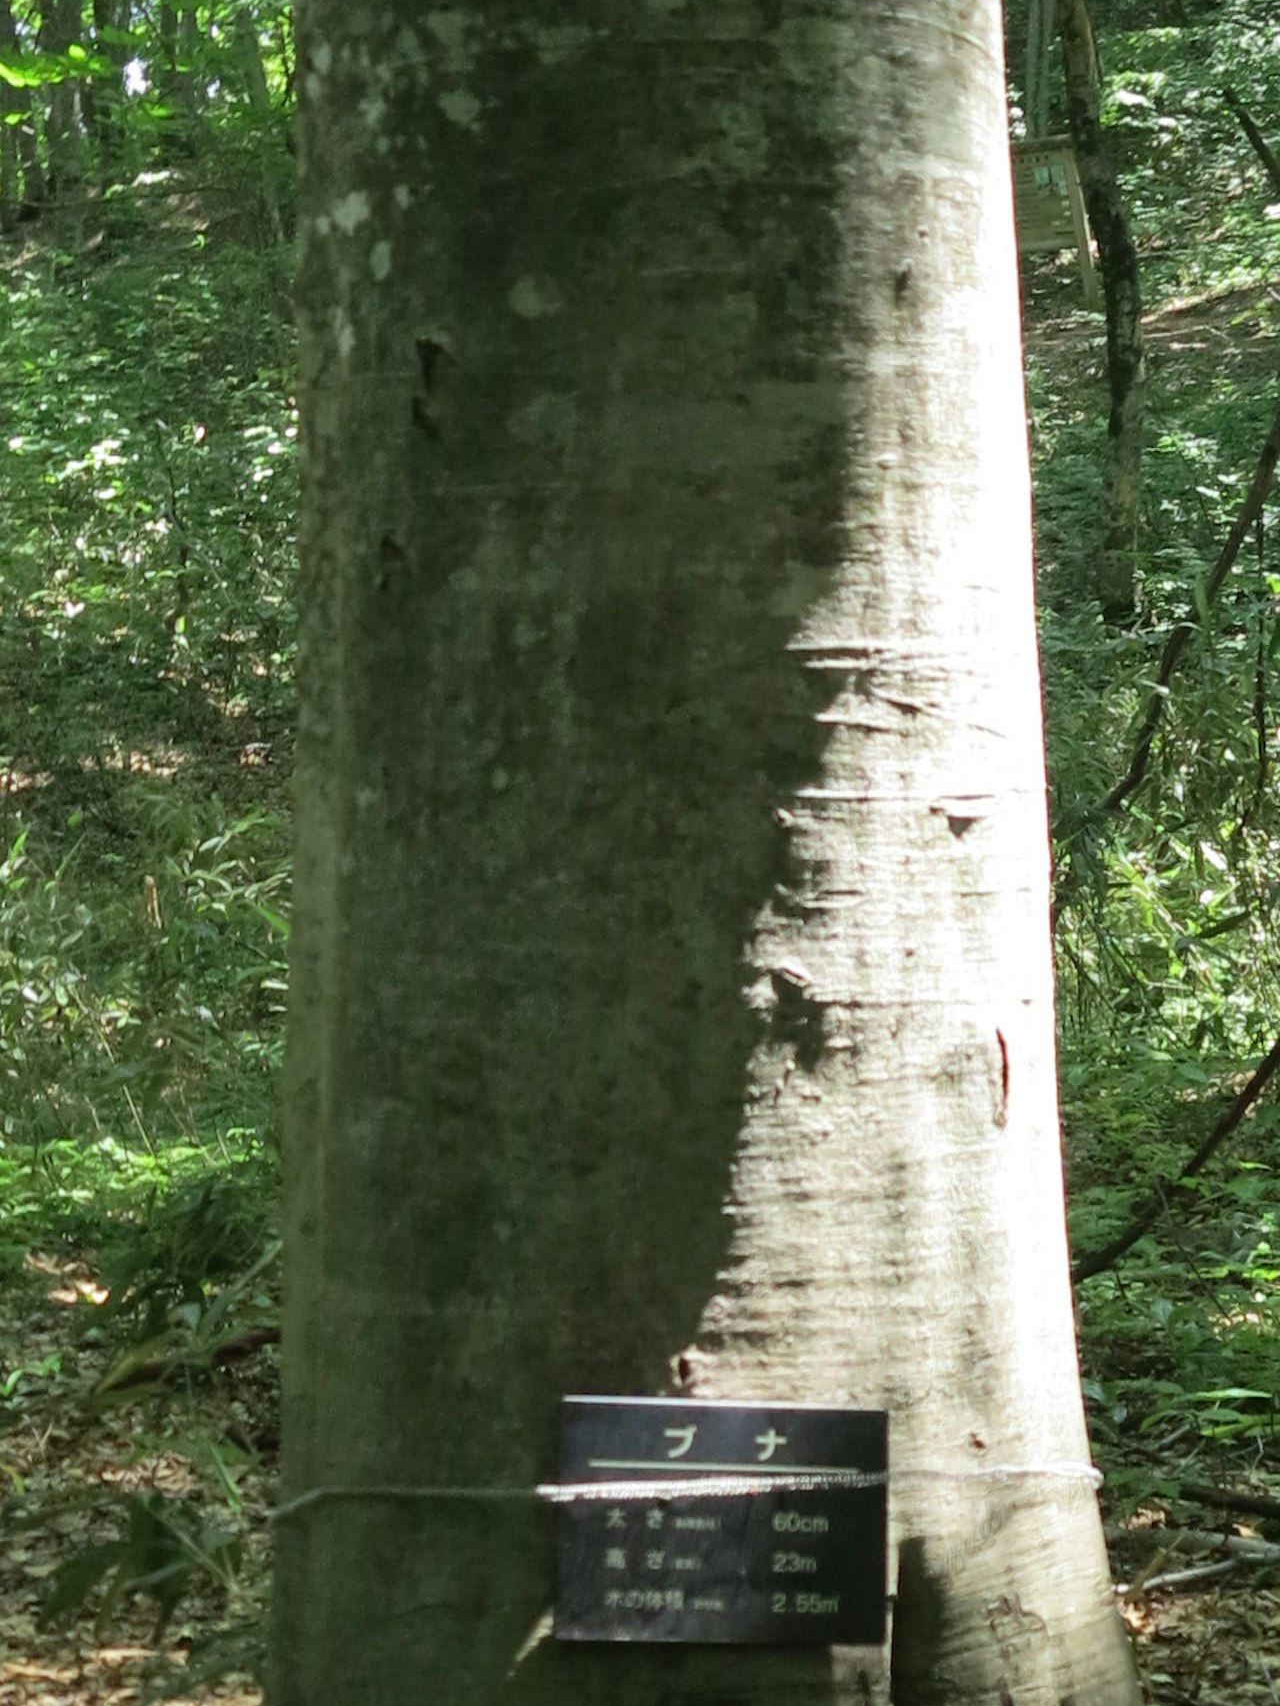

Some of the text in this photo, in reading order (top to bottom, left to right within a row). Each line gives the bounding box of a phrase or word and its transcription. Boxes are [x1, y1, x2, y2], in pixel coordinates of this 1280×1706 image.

[663, 1423, 788, 1461] ブナ
[772, 1511, 829, 1533] 60cm
[772, 1550, 817, 1573] 23m
